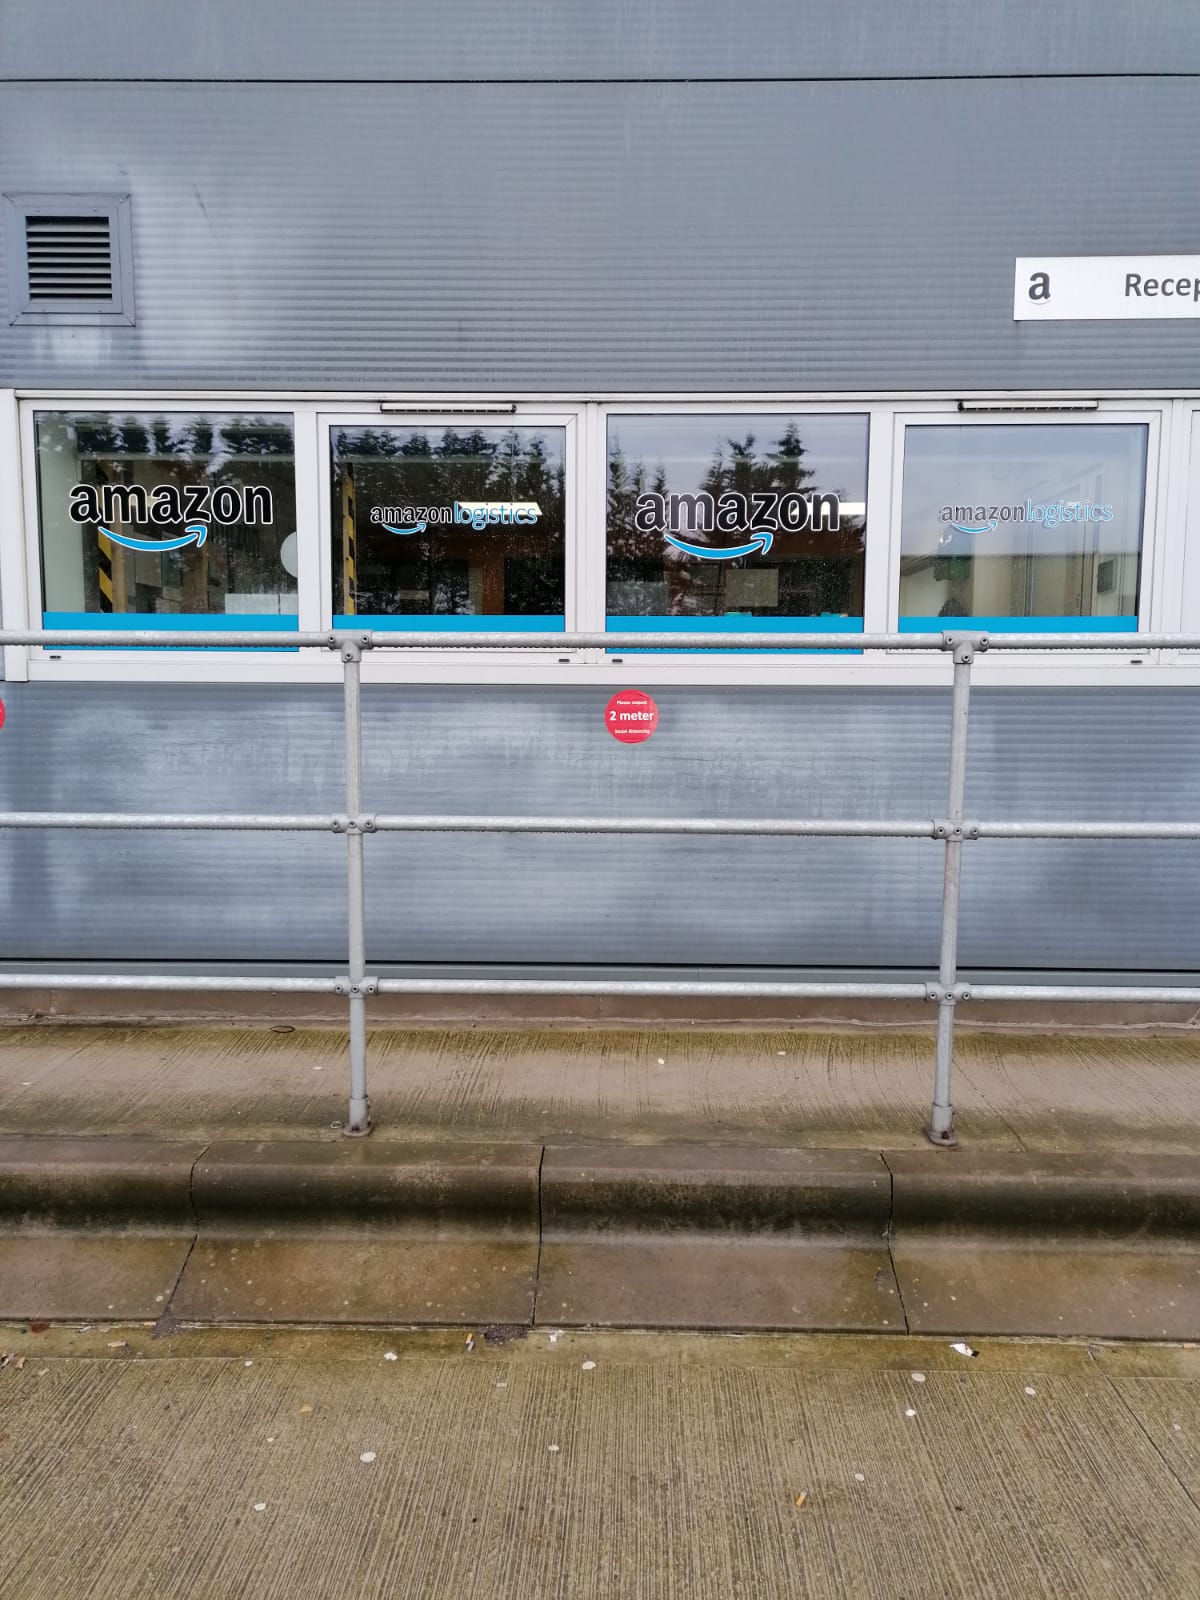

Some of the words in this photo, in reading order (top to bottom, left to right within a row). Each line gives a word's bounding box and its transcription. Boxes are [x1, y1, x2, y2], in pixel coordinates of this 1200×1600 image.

[1028, 272, 1051, 300] a
[69, 483, 274, 525] amazon
[634, 492, 840, 532] amazon
[609, 710, 617, 720] 2
[619, 710, 654, 720] meter
